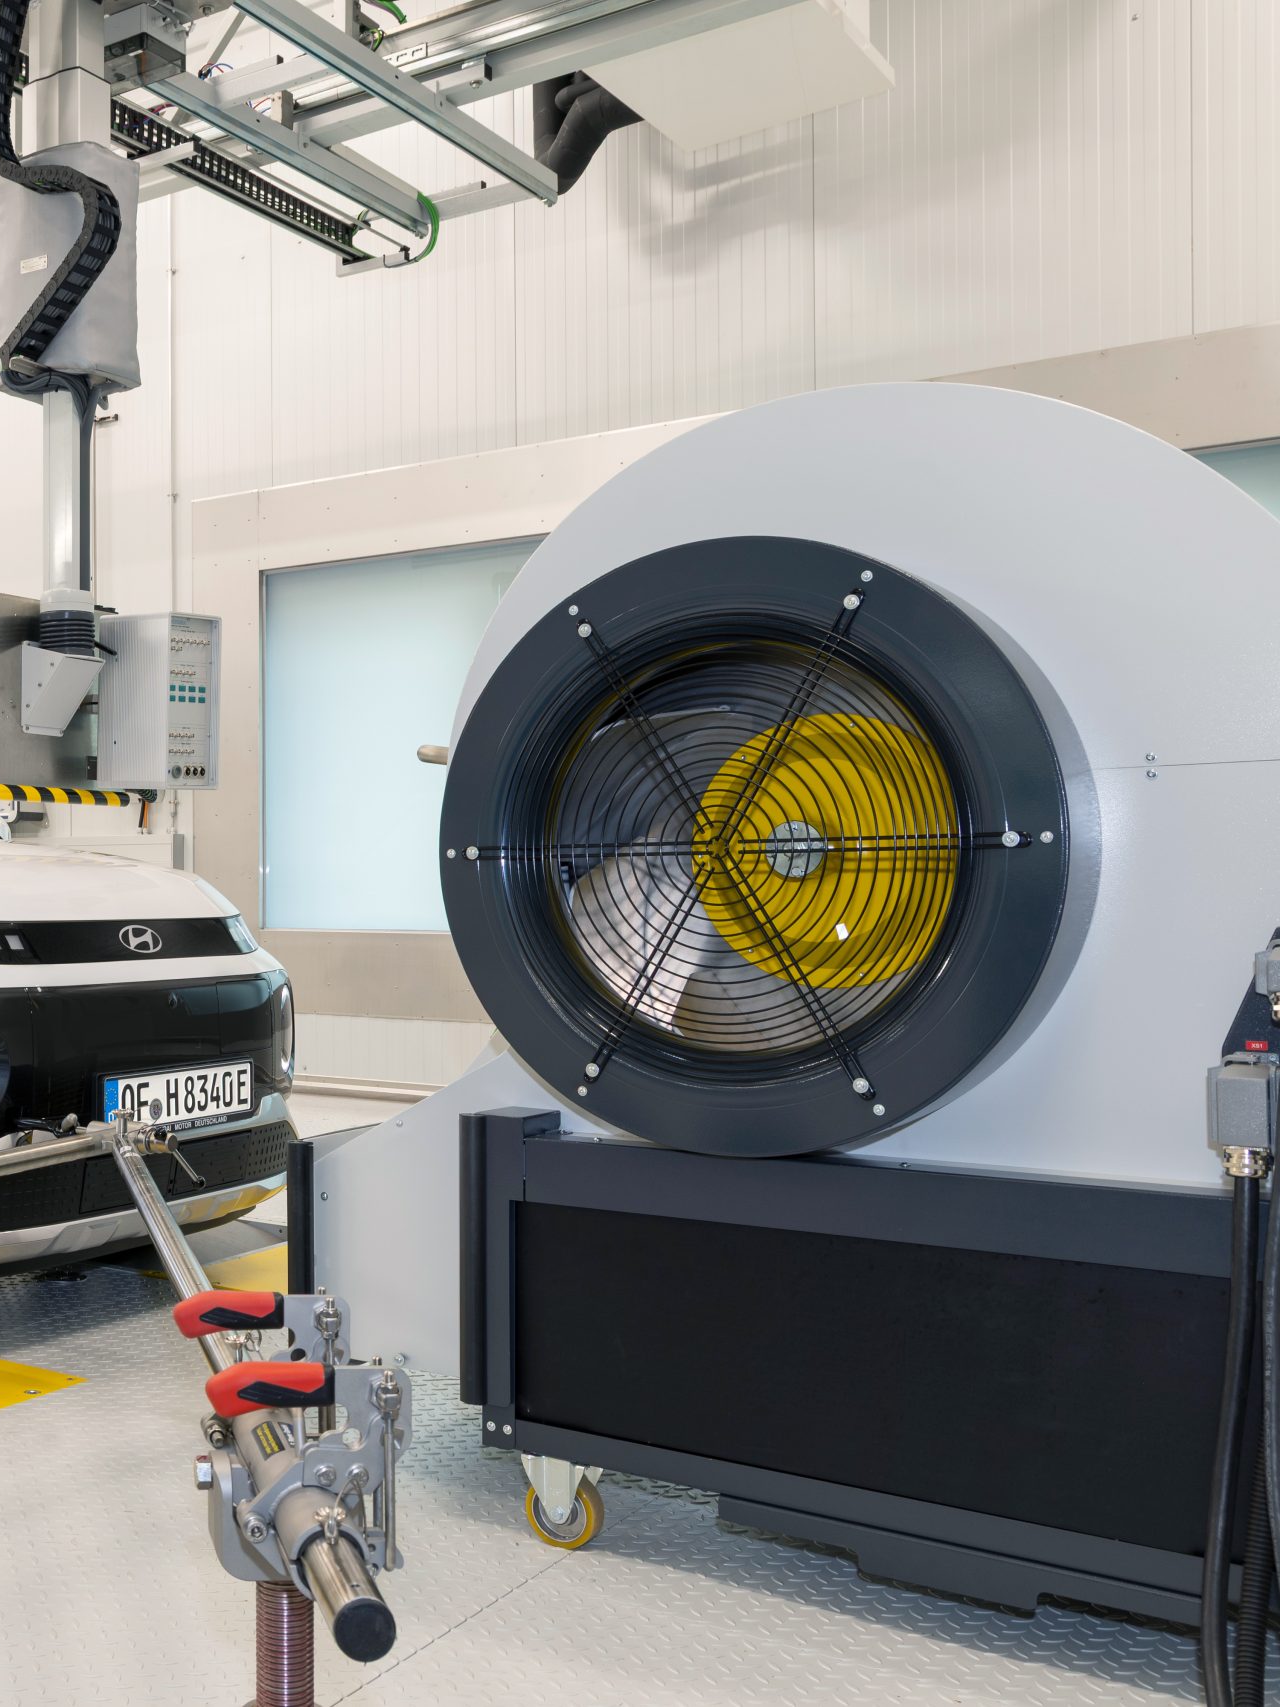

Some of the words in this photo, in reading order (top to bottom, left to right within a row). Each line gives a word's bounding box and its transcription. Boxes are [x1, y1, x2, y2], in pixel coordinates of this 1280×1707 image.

[121, 1082, 149, 1121] OF
[174, 1120, 192, 1131] MOTOR
[194, 1115, 228, 1127] DEUTSCHLAND
